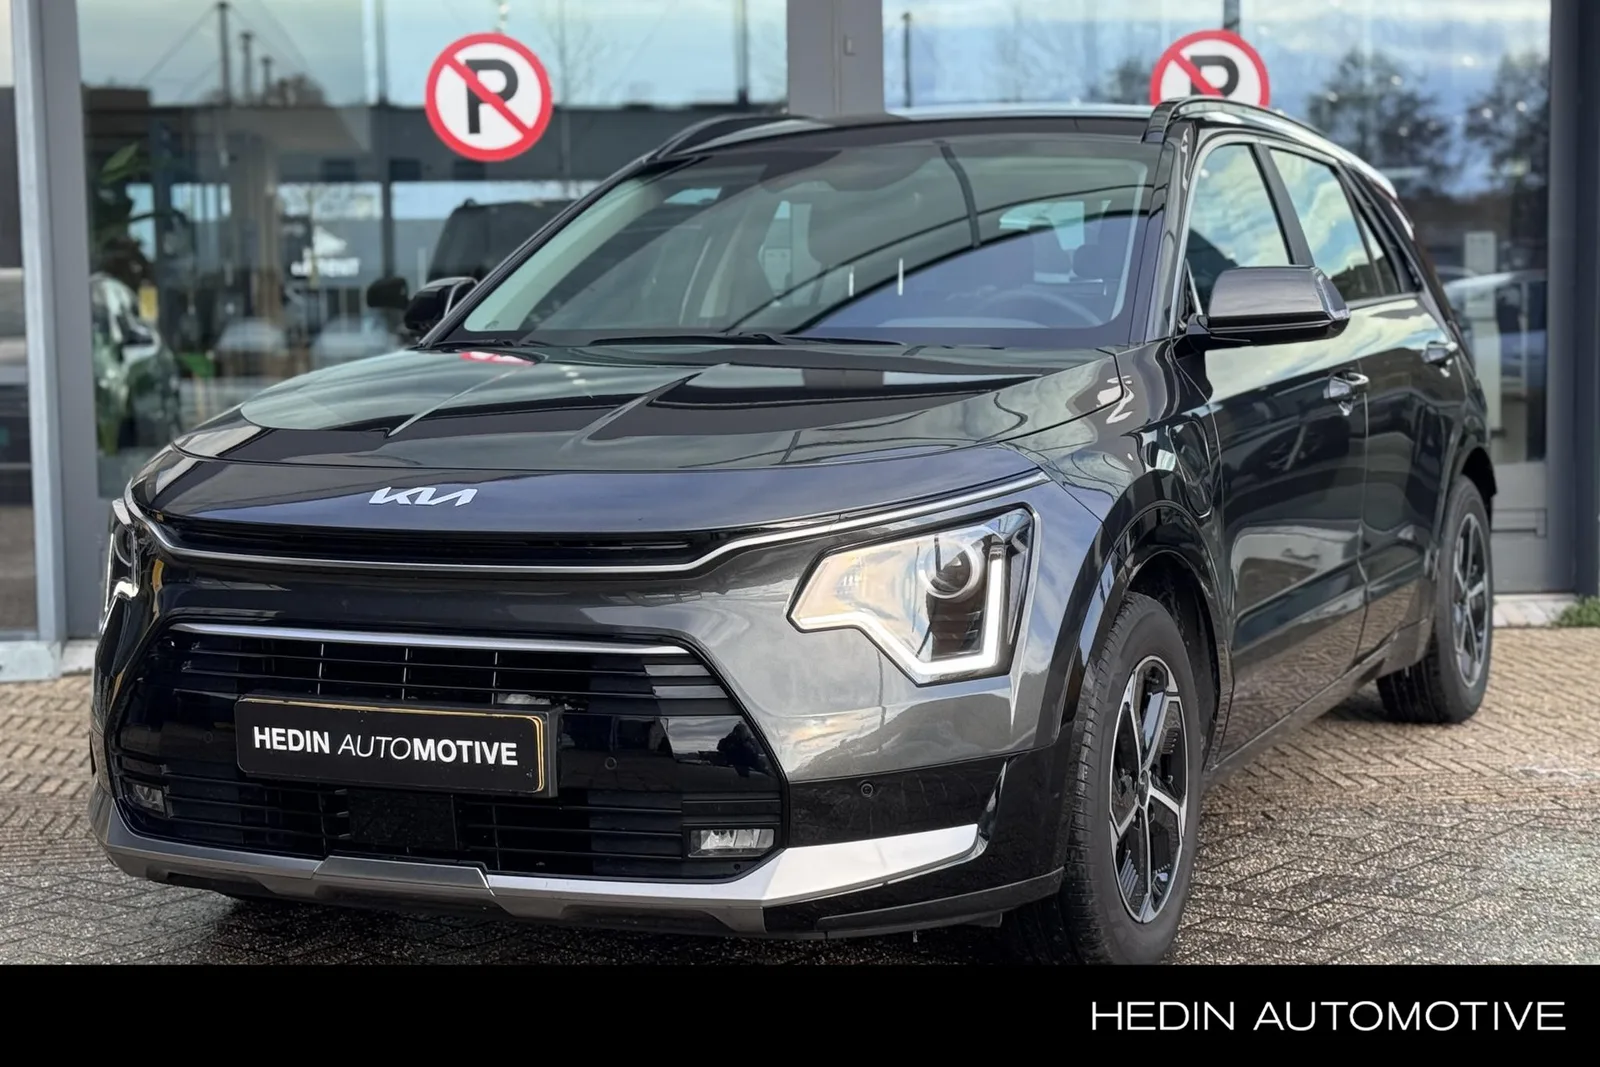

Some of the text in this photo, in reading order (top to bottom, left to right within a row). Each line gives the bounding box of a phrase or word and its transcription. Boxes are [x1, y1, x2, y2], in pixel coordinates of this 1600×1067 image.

[465, 58, 518, 134] P
[1190, 55, 1239, 98] P
[252, 725, 519, 766] HEDIN AUTOMOTIVE
